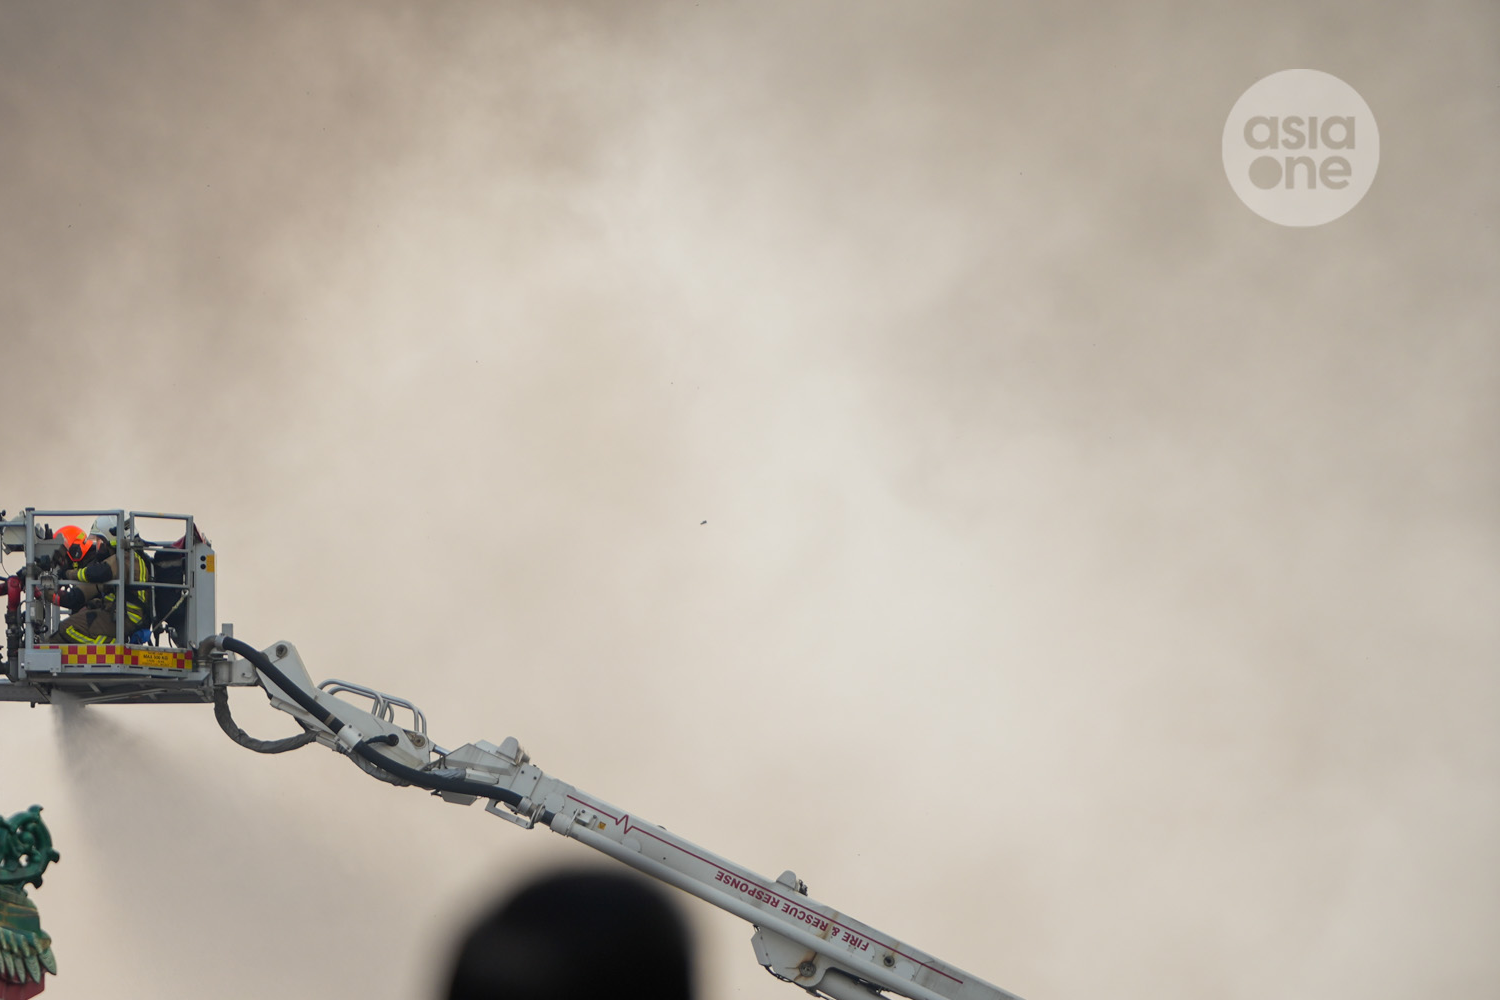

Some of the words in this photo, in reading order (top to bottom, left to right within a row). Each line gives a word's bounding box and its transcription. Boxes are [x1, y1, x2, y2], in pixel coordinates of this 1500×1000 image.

[714, 870, 781, 908] RESPONSE
[781, 902, 829, 932] RESCUE
[831, 926, 841, 937] &
[841, 931, 870, 952] FIRE
